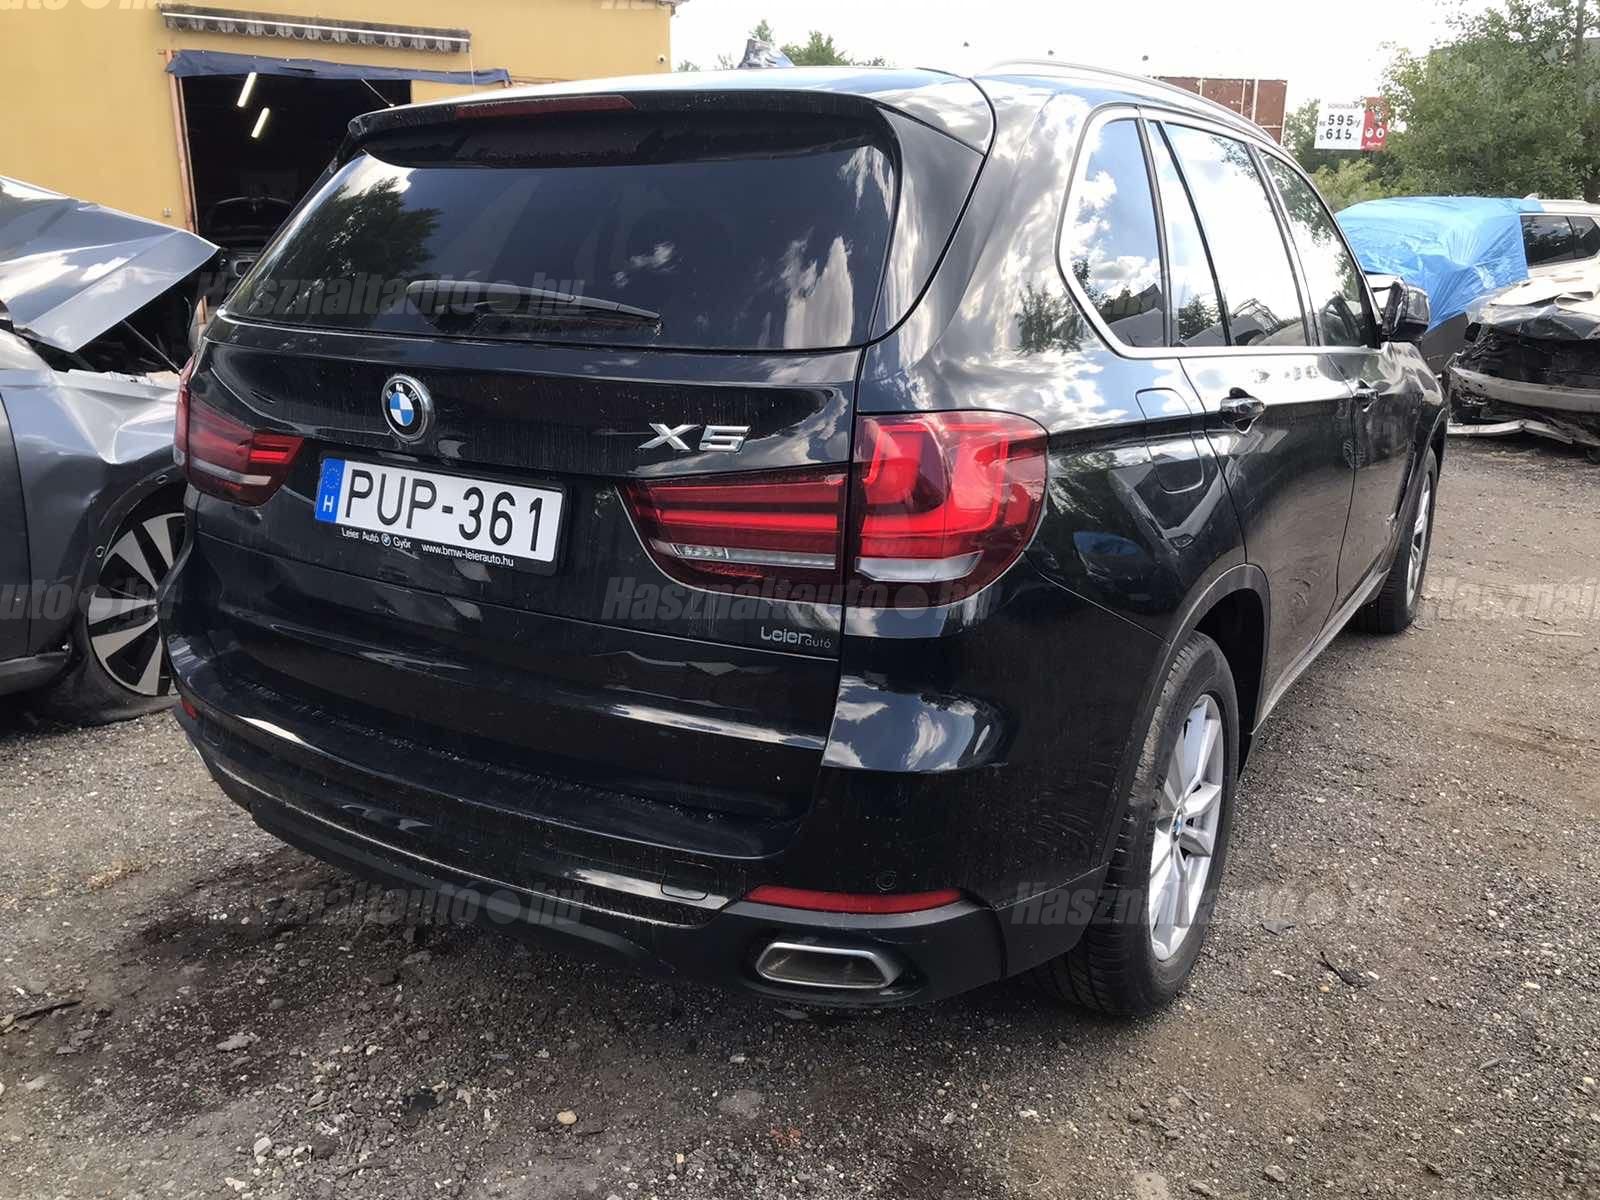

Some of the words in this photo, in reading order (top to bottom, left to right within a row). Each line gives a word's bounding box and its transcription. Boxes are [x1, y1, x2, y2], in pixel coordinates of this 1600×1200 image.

[1328, 114, 1354, 126] 595
[1326, 128, 1352, 140] 615
[638, 423, 751, 452] X5
[322, 495, 335, 513] H
[345, 469, 543, 552] PUP-361
[341, 527, 360, 539] Leier
[421, 543, 515, 567] www.bmw-leierauto.hu
[761, 626, 812, 645] Leier
[805, 638, 833, 649] autó
